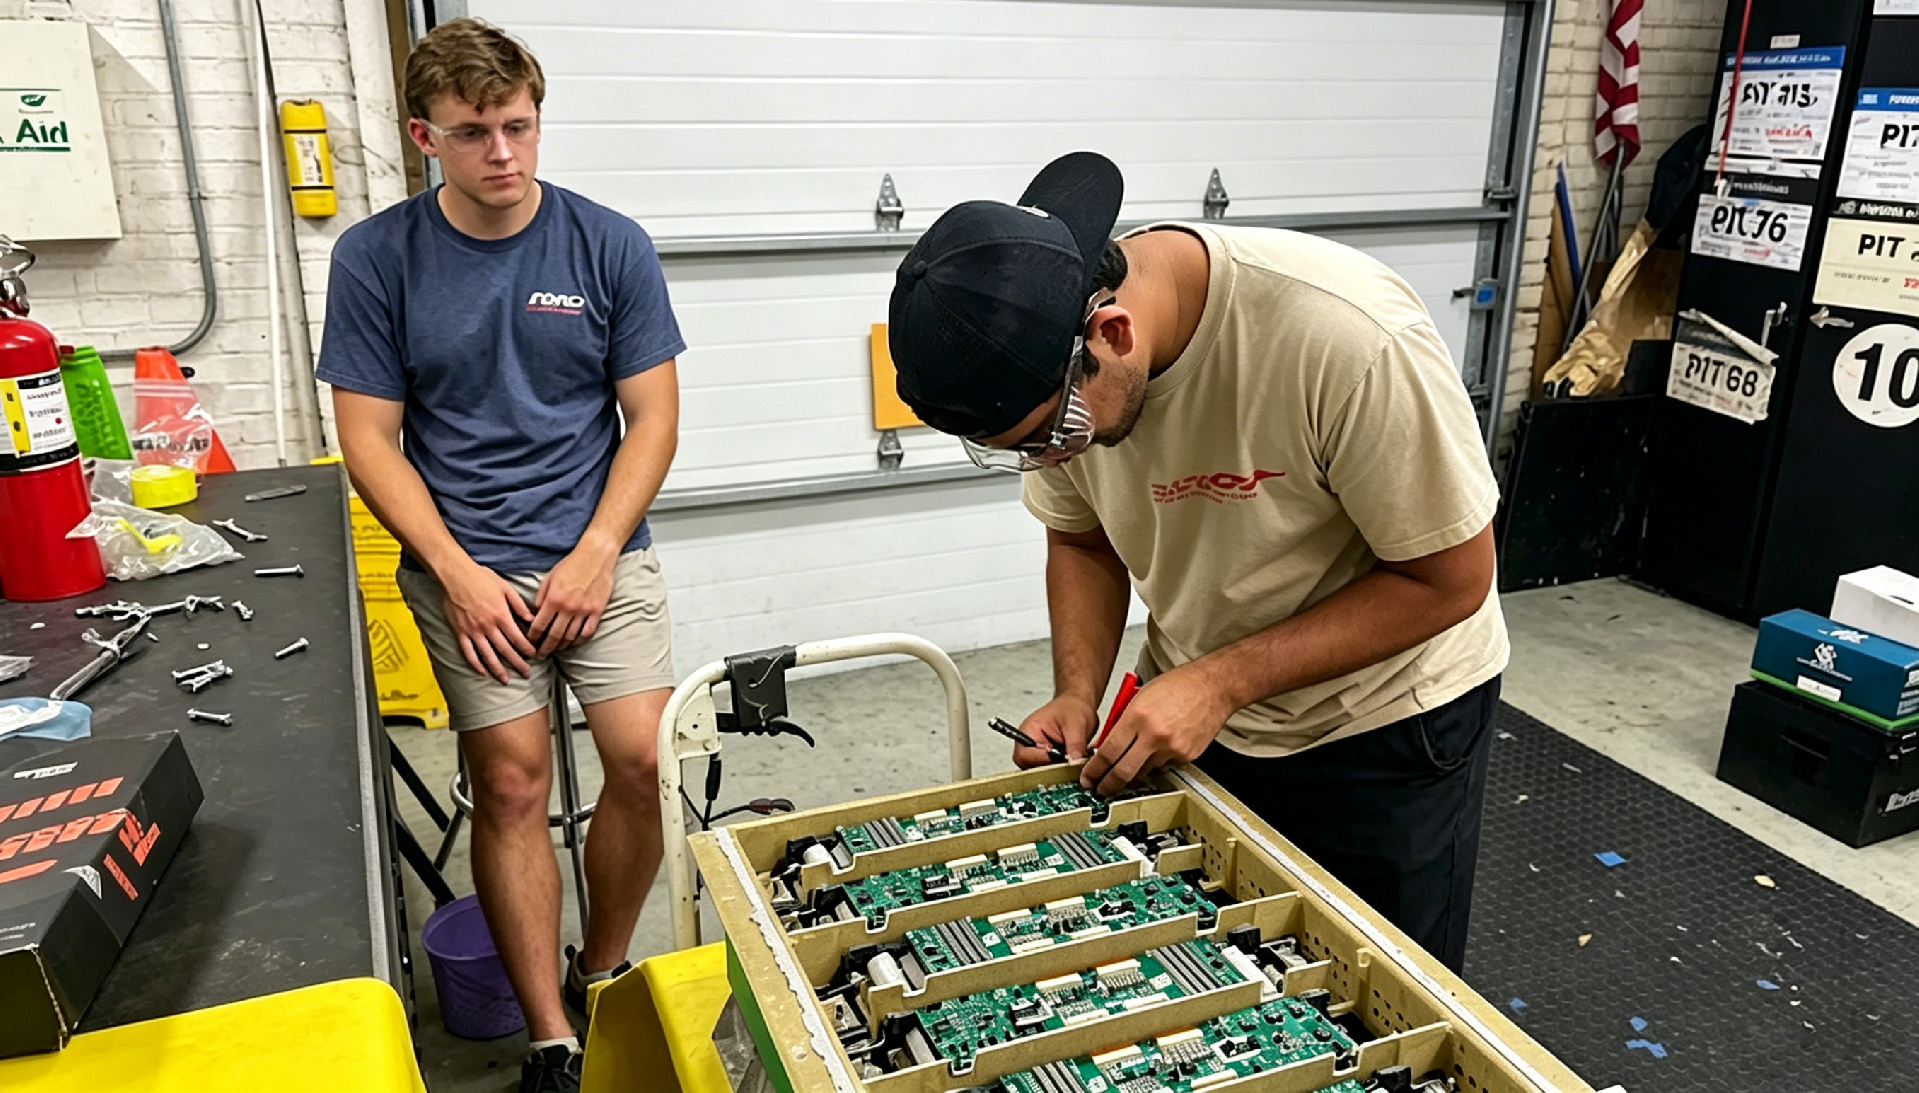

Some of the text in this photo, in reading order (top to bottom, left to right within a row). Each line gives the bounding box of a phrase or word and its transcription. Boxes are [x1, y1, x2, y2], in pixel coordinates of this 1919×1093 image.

[16, 118, 68, 143] Aid
[1752, 209, 1788, 242] 76
[1858, 233, 1905, 258] PIT
[1855, 343, 1919, 409] 10
